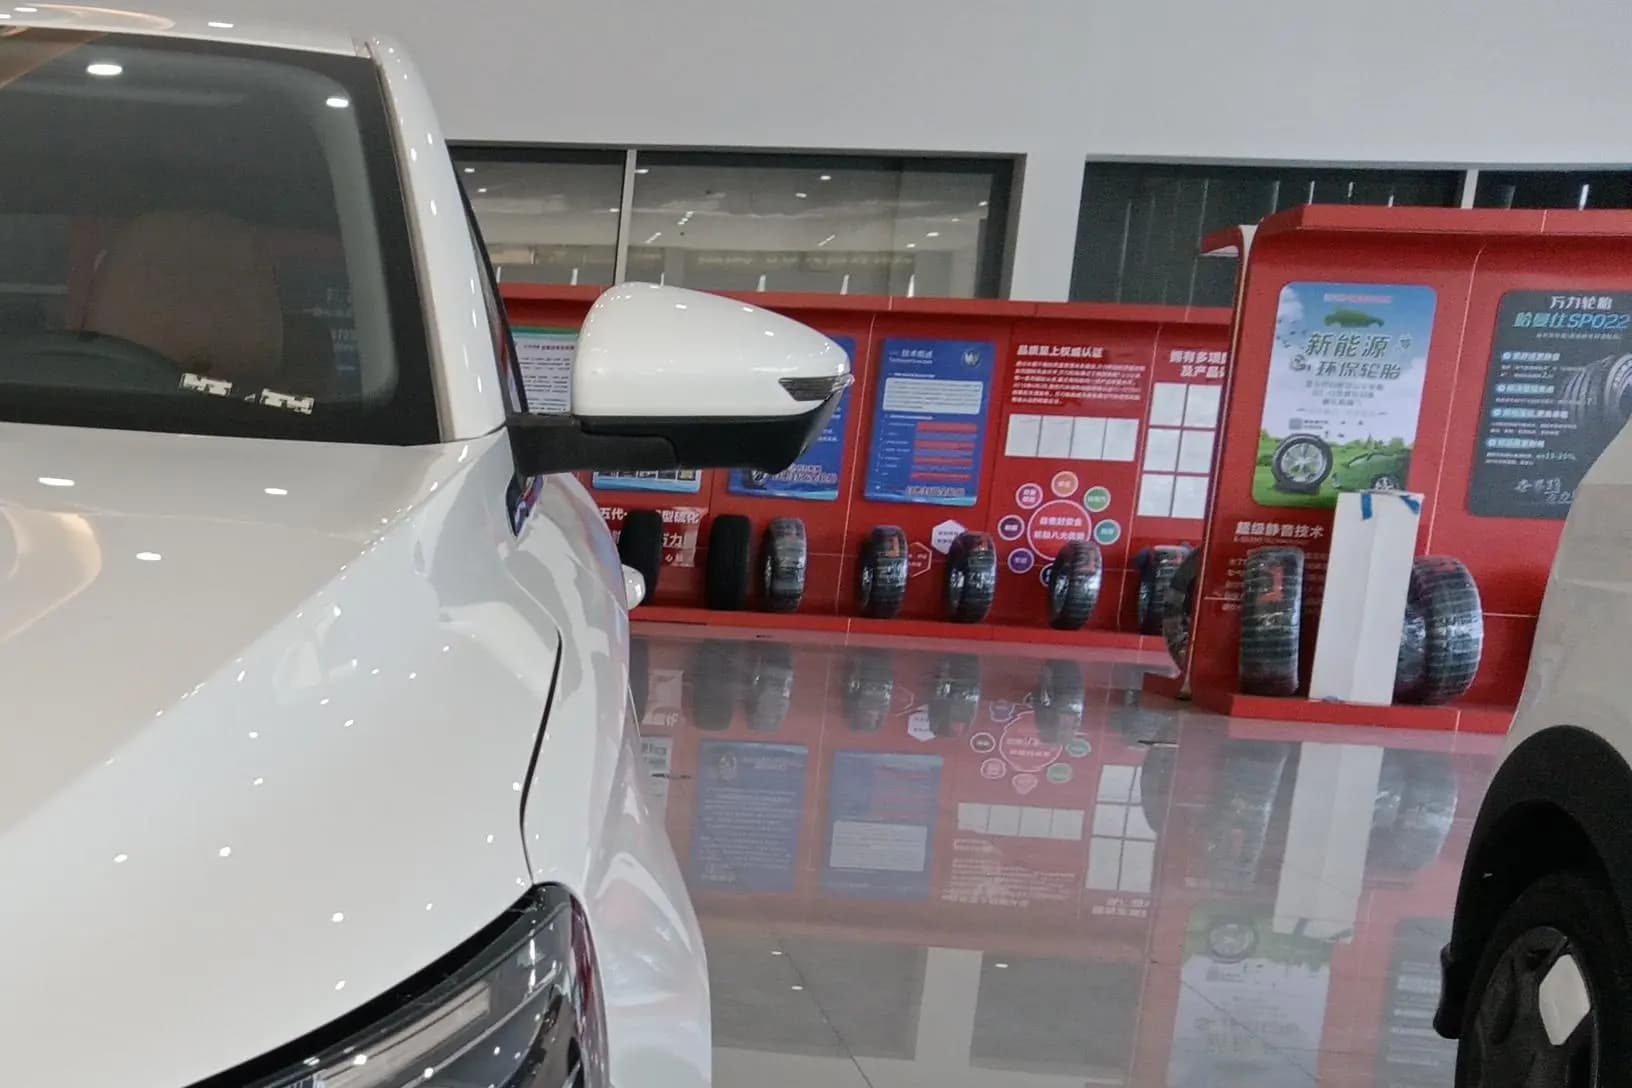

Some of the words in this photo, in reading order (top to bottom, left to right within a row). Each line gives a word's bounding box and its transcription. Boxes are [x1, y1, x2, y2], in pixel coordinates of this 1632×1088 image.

[1550, 295, 1613, 310] 万力轮胎
[1305, 333, 1390, 358] 新能源
[1316, 361, 1401, 380] 环保轮胎
[1234, 521, 1325, 538] 超级静音技术
